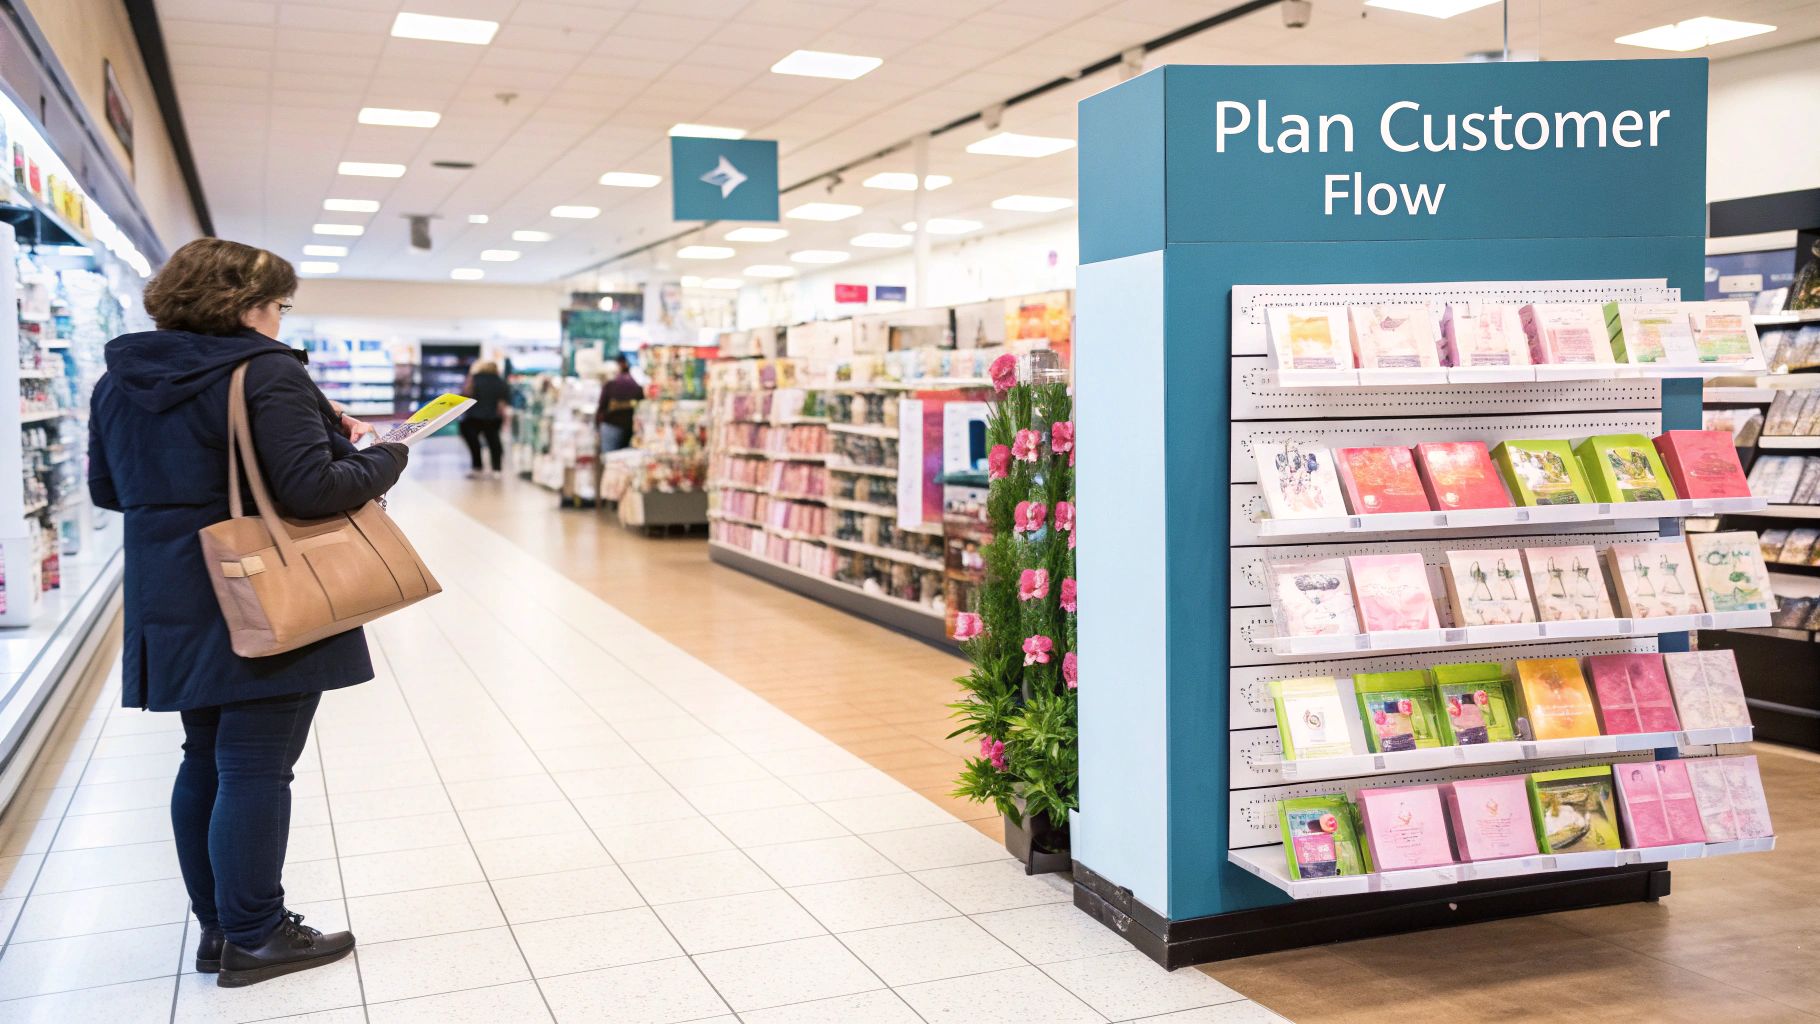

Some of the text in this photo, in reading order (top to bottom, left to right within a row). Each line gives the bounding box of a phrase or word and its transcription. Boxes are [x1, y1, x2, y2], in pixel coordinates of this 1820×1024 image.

[1216, 99, 1671, 154] Plan Customer
[1324, 171, 1447, 216] Flow
